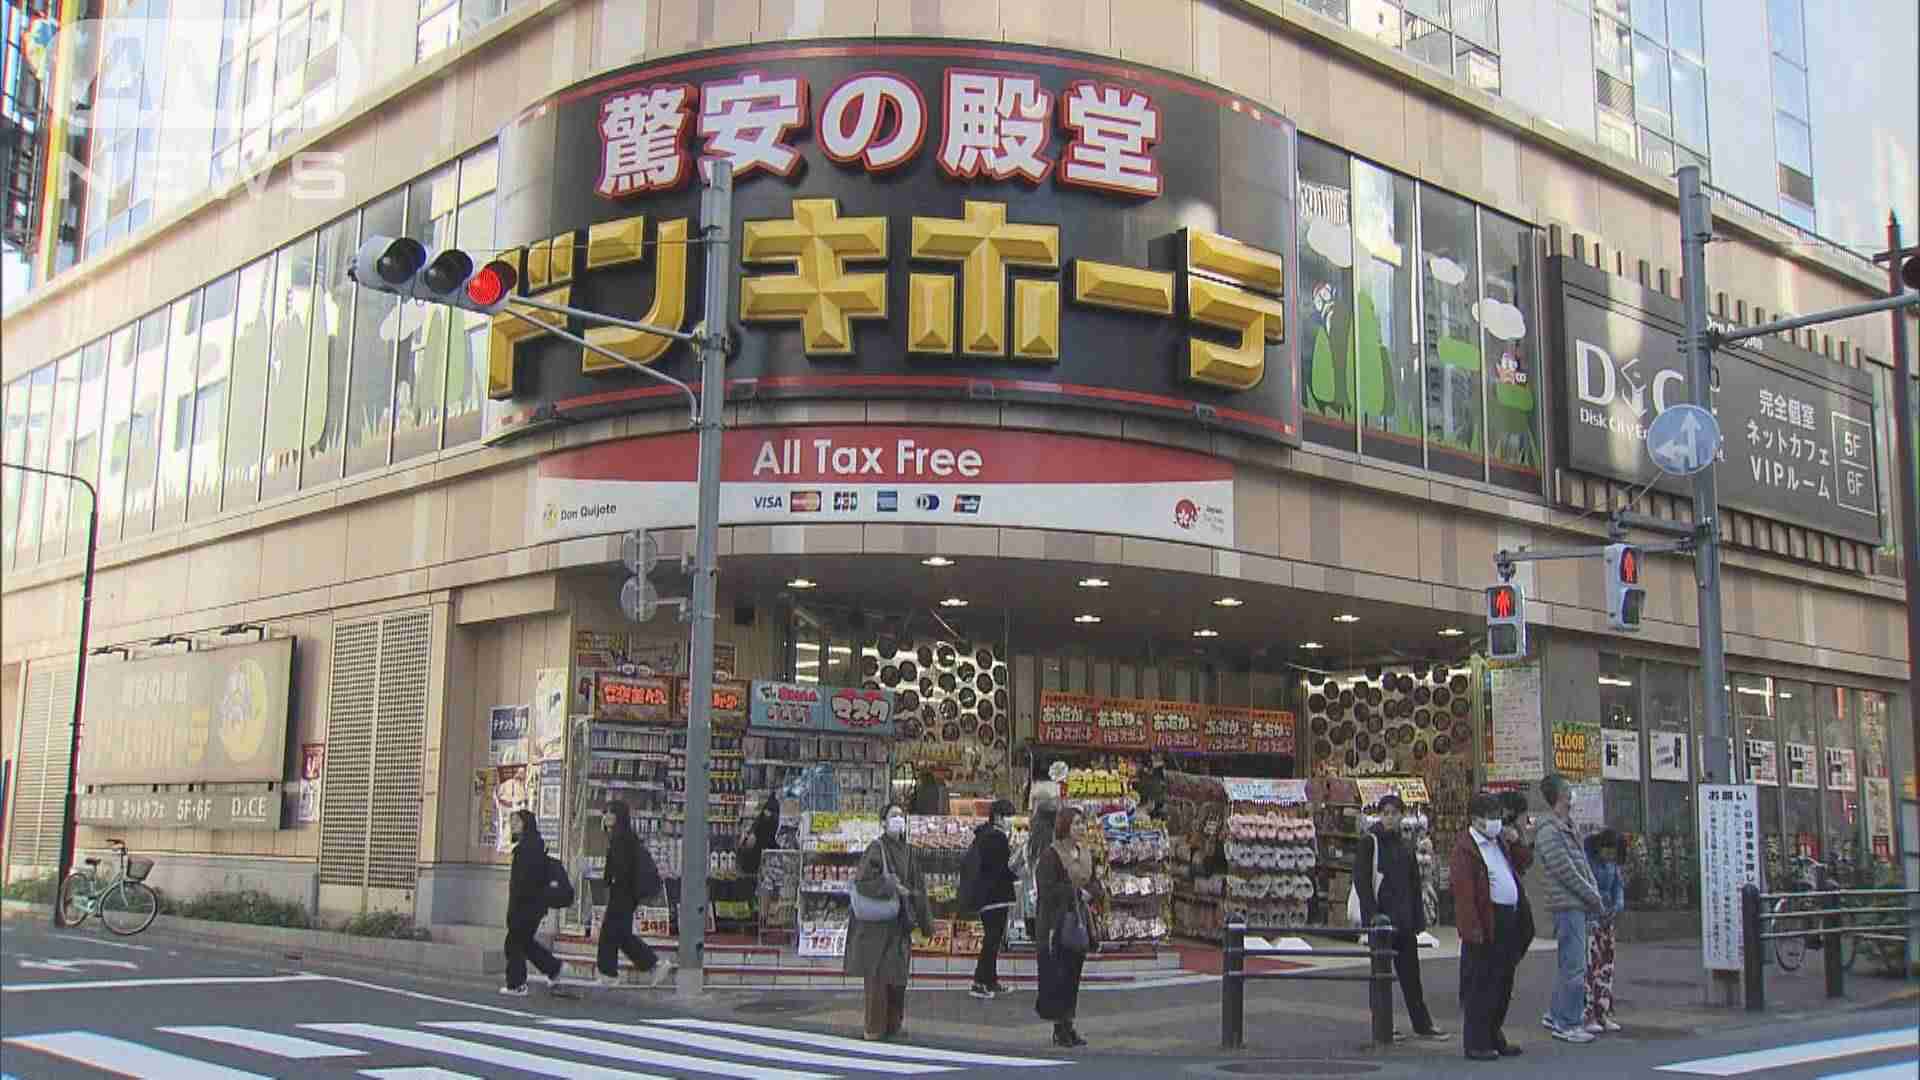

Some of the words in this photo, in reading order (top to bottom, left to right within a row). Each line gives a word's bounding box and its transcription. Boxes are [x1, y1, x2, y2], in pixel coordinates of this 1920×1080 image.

[595, 70, 1162, 198] 驚安の殿堂
[1758, 388, 1816, 430] 完全個室
[1580, 407, 1608, 430] Disk
[1609, 416, 1635, 441] City
[1746, 418, 1831, 467] ネットカフェ
[1844, 431, 1861, 458] 5F
[753, 439, 801, 476] All
[814, 439, 884, 476] Tax
[896, 439, 984, 477] Free
[1750, 455, 1831, 501] VIPルーム
[1846, 470, 1864, 496] 6F
[560, 510, 578, 521] Don
[580, 504, 617, 518] Quijote
[754, 495, 783, 509] VISA
[831, 696, 889, 723] マスク
[1553, 733, 1585, 751] FLOOR
[1555, 752, 1585, 769] GUIDE
